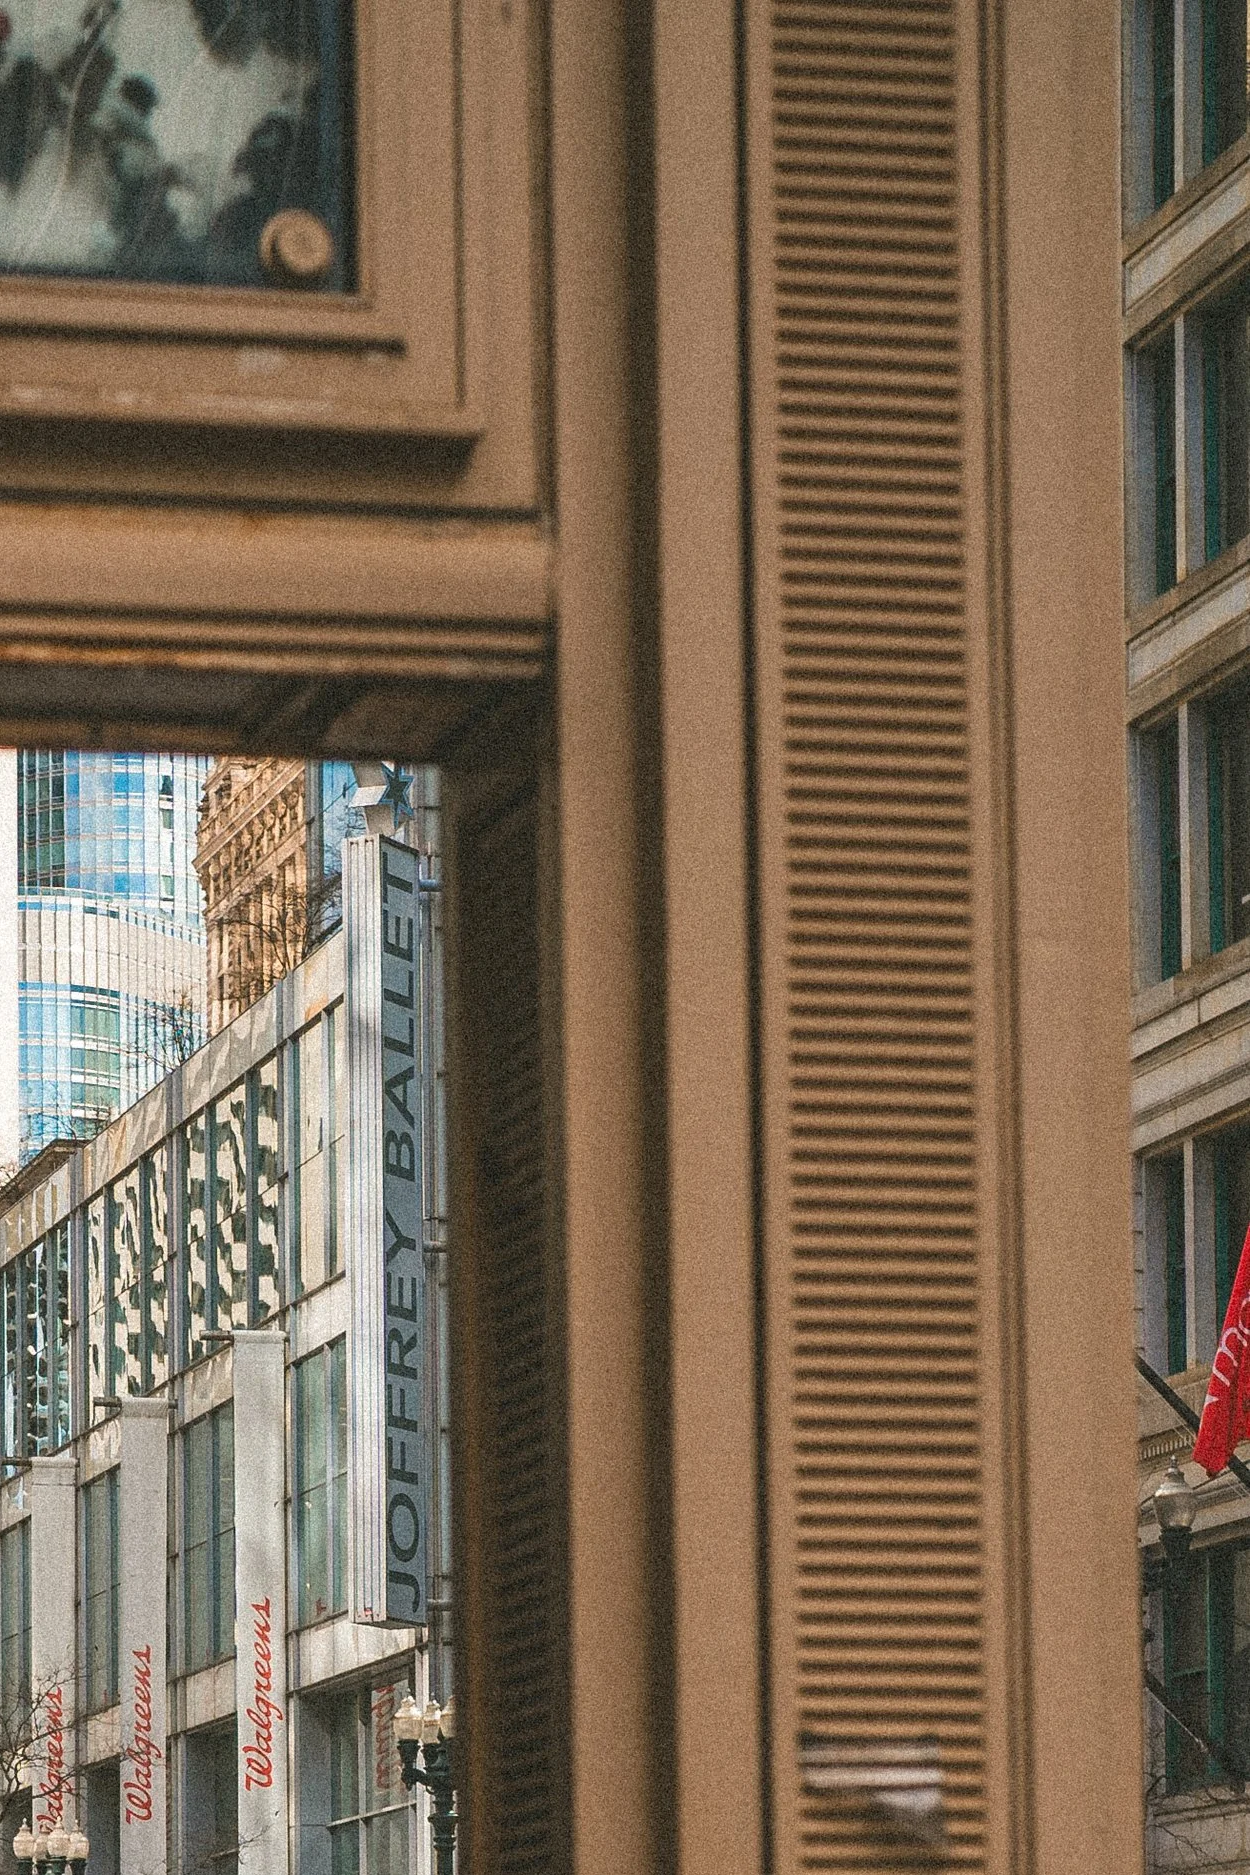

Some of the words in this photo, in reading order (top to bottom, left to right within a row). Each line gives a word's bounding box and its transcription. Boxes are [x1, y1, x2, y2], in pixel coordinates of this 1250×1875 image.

[381, 850, 417, 1179] BALLET
[384, 1227, 421, 1614] JOFFREY
[123, 1645, 163, 1825] Walgreens
[243, 1595, 284, 1792] Walgreens
